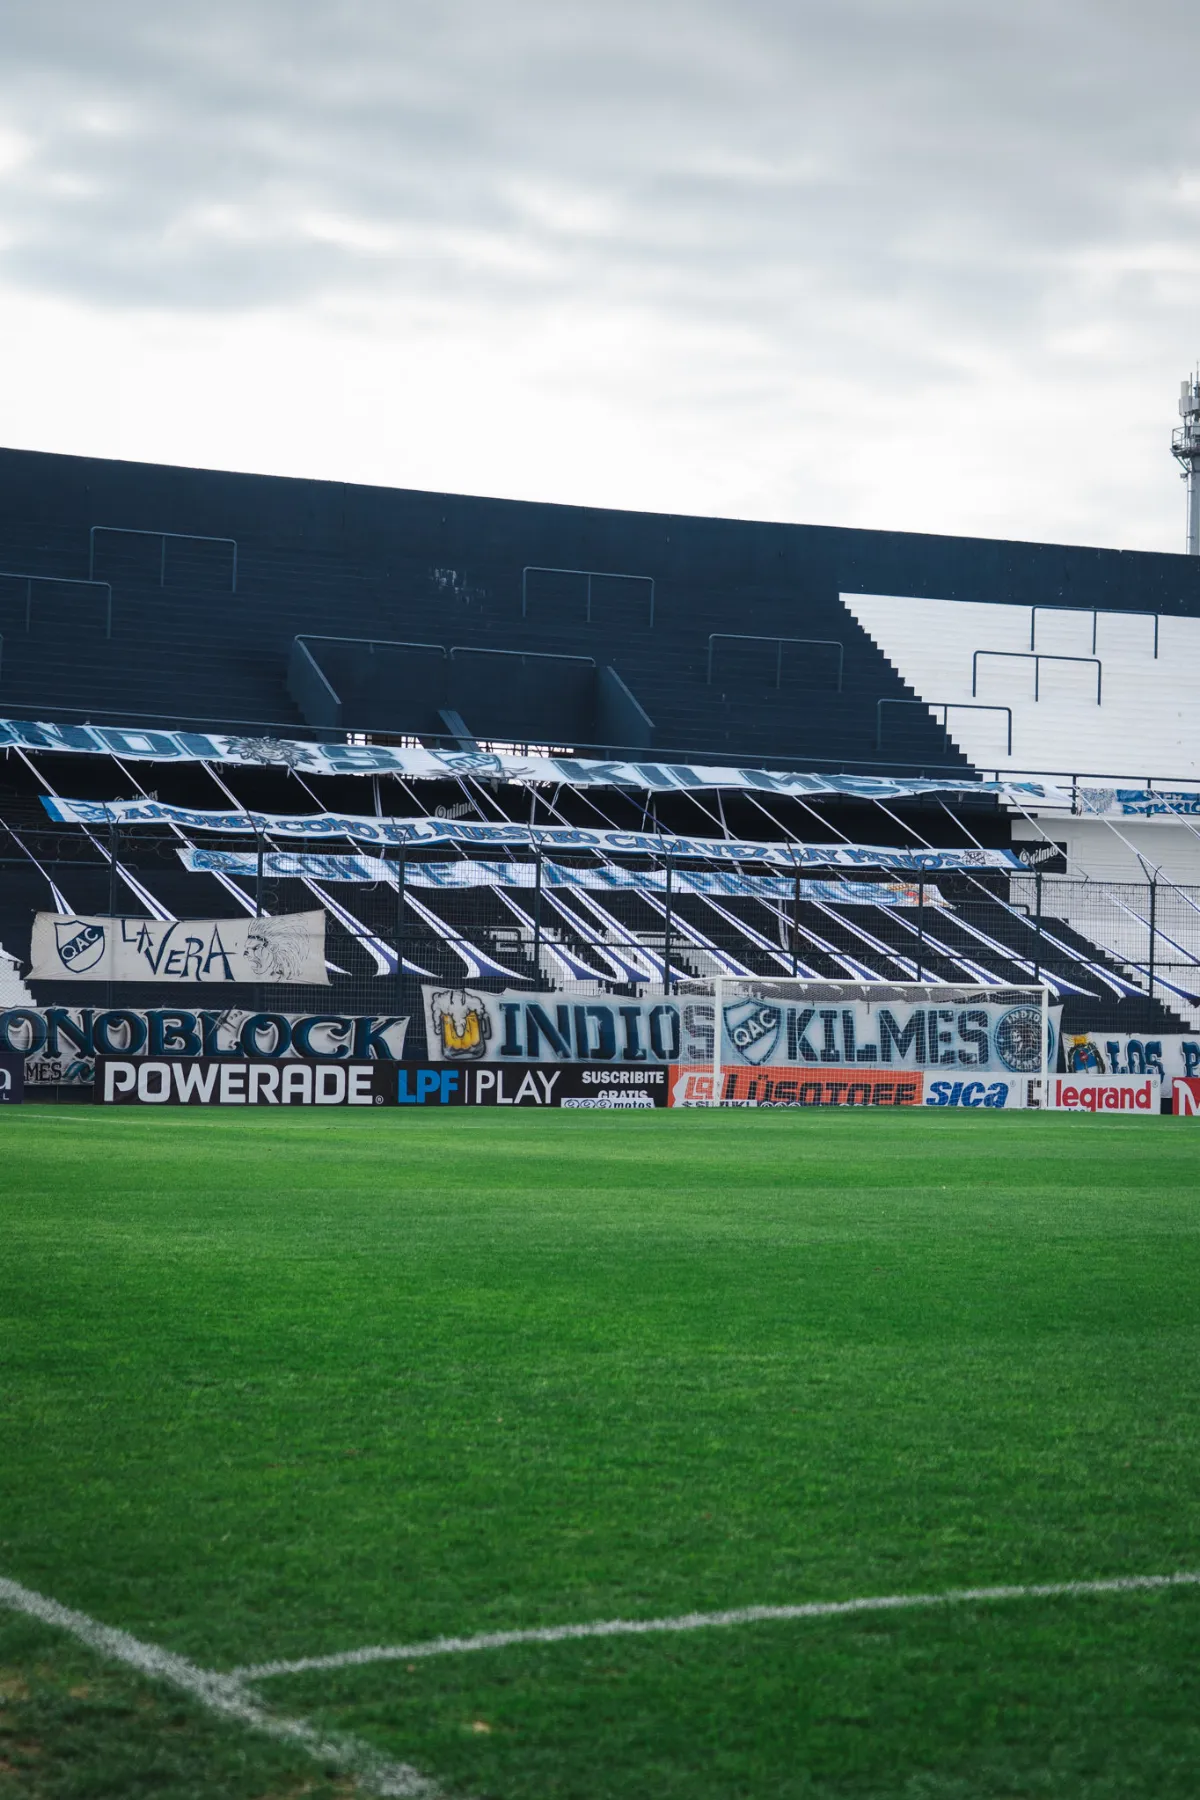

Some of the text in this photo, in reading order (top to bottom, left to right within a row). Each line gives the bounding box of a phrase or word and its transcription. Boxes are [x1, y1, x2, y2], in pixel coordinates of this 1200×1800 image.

[122, 803, 273, 829] AMORES
[276, 817, 380, 839] COMO
[378, 823, 433, 842] EL
[427, 821, 601, 844] NUESTRO
[61, 928, 99, 961] QAC
[121, 919, 156, 954] LA
[144, 921, 238, 982] VERA
[499, 1003, 716, 1061] INDIOS
[733, 1009, 777, 1047] QAC
[787, 1006, 989, 1065] KILMES
[1006, 1010, 1042, 1028] INDIO
[103, 1061, 375, 1105] POWERADE
[398, 1069, 562, 1105] LPF PLAY
[581, 1070, 665, 1085] SUSCRIBITE
[1055, 1079, 1152, 1113] legrand
